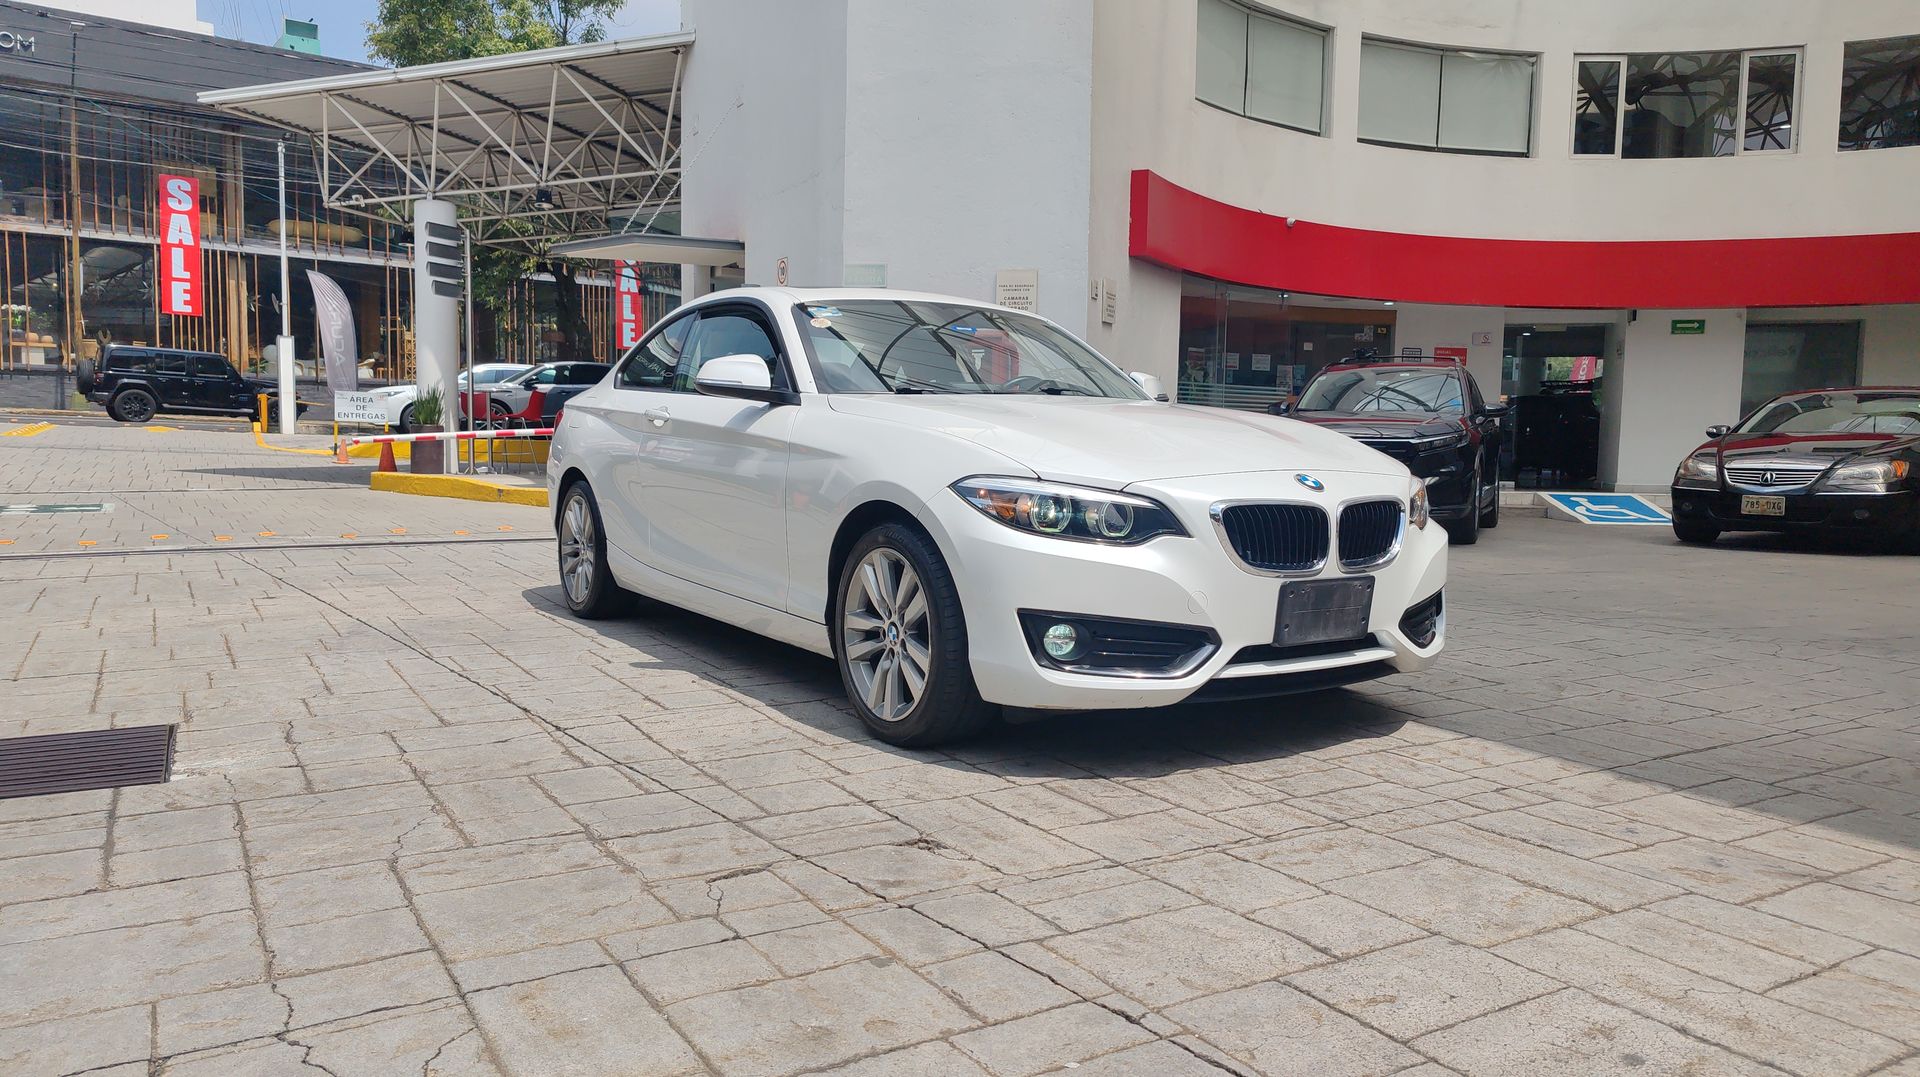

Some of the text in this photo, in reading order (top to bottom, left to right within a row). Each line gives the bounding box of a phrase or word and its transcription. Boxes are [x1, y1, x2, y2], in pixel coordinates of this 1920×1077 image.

[166, 178, 195, 313] SALE
[620, 258, 639, 348] ALE
[337, 412, 386, 420] ENTREGAS
[350, 394, 374, 404] ÁREA
